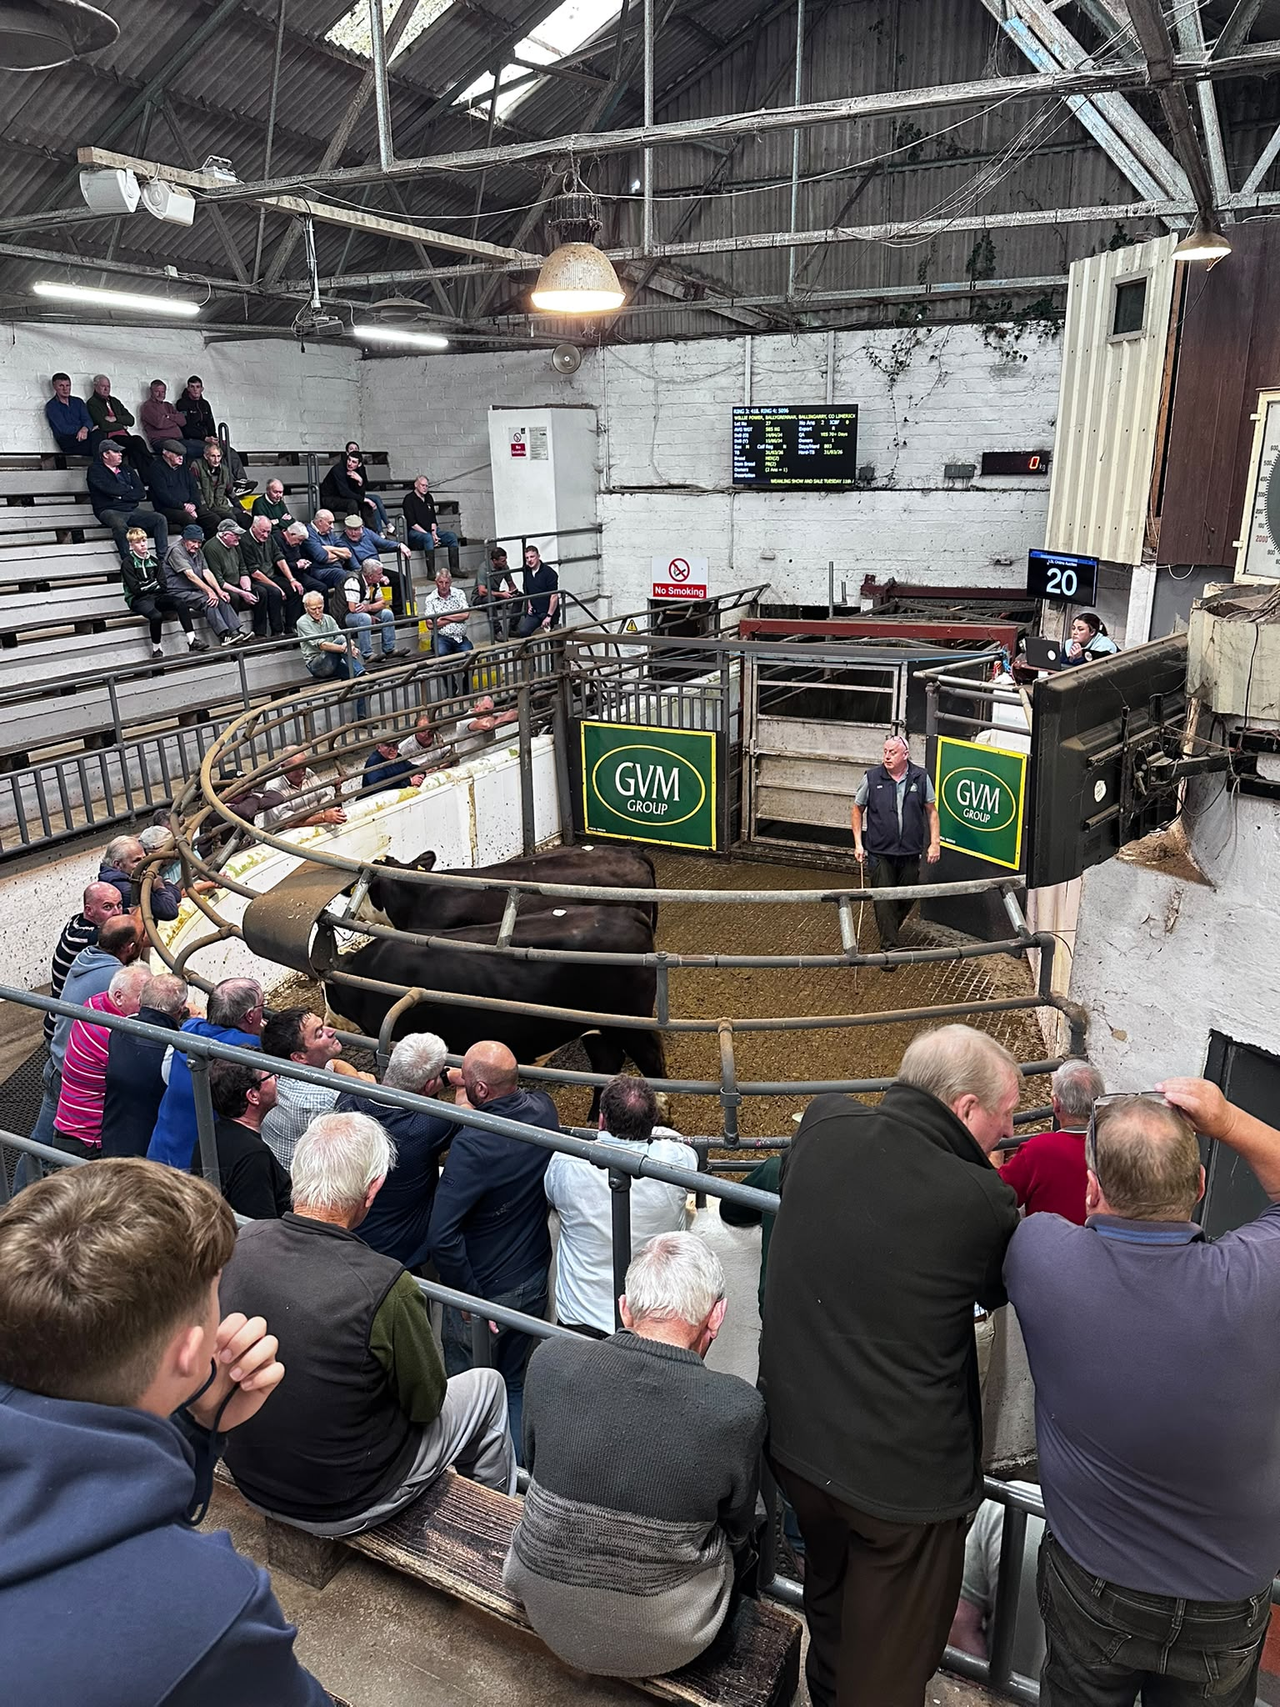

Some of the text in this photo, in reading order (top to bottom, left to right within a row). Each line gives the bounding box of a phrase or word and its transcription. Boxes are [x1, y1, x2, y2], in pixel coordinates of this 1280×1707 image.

[1029, 456, 1040, 469] 0
[1255, 534, 1268, 543] 2000
[1046, 567, 1078, 596] 20
[655, 586, 704, 598] No Smoking
[615, 761, 680, 801] GVM
[957, 779, 1000, 814] GVM
[627, 799, 668, 815] GROUP
[963, 808, 991, 823] GROUP
